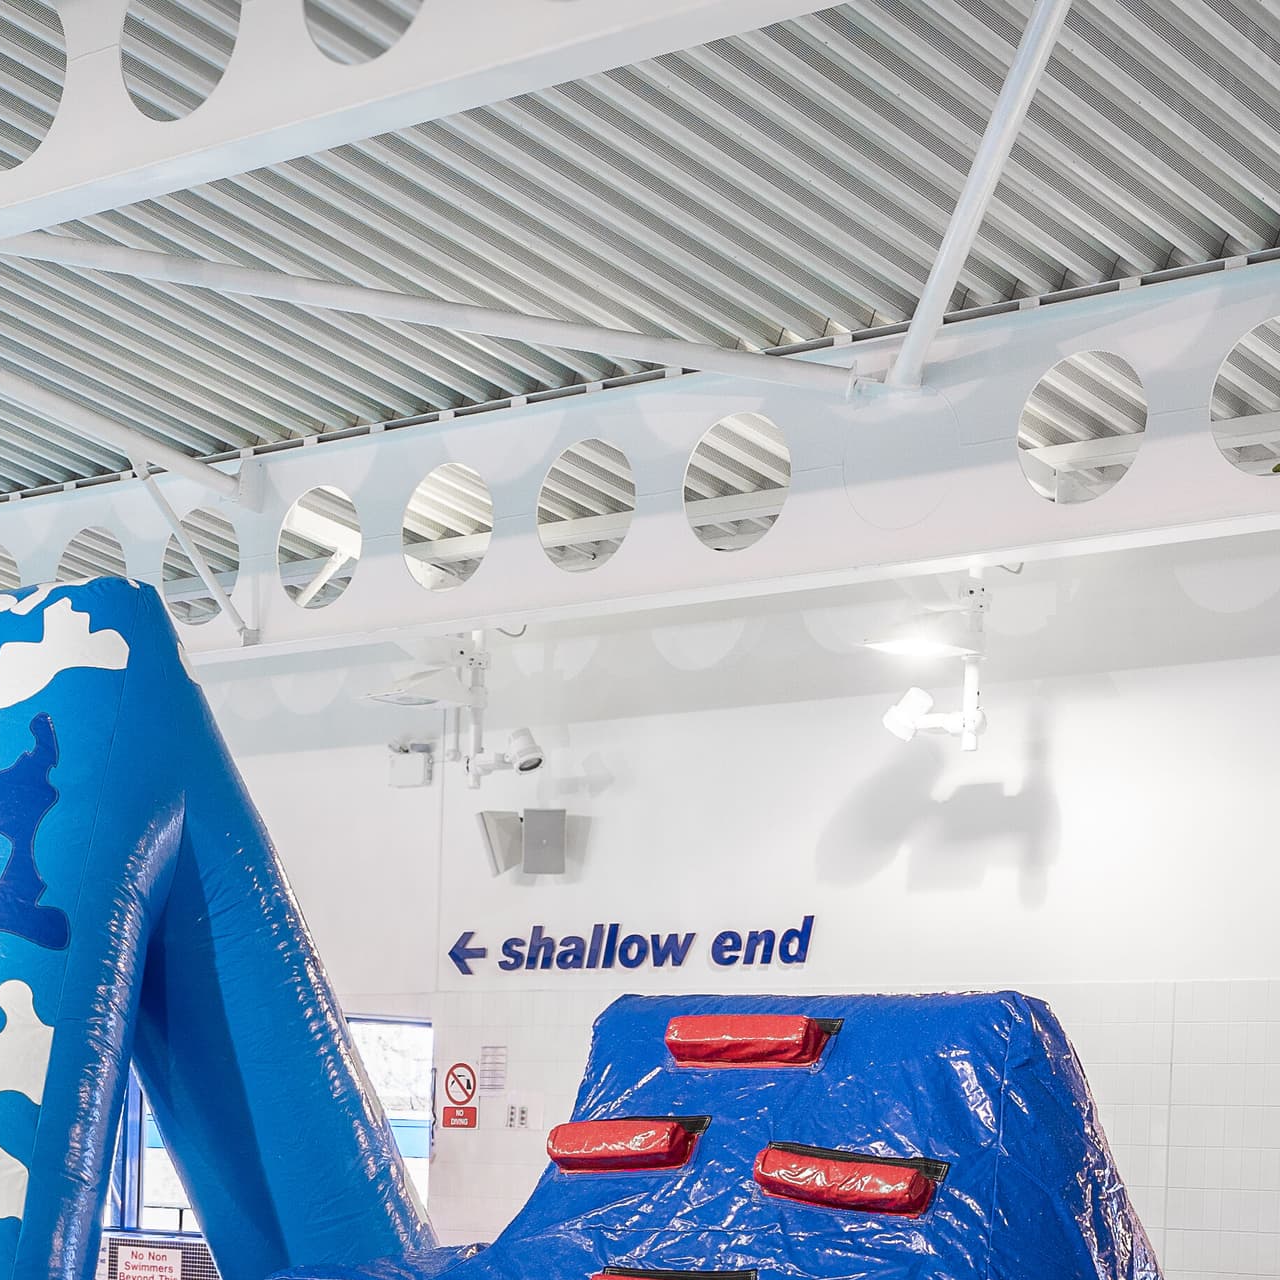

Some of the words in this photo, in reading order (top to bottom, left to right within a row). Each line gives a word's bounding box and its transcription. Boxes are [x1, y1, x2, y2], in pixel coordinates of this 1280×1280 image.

[498, 923, 697, 971] shallow
[712, 915, 815, 966] end
[455, 1109, 464, 1117] NO
[131, 1250, 144, 1261] No
[148, 1251, 167, 1262] Non
[124, 1261, 174, 1274] Swimmers
